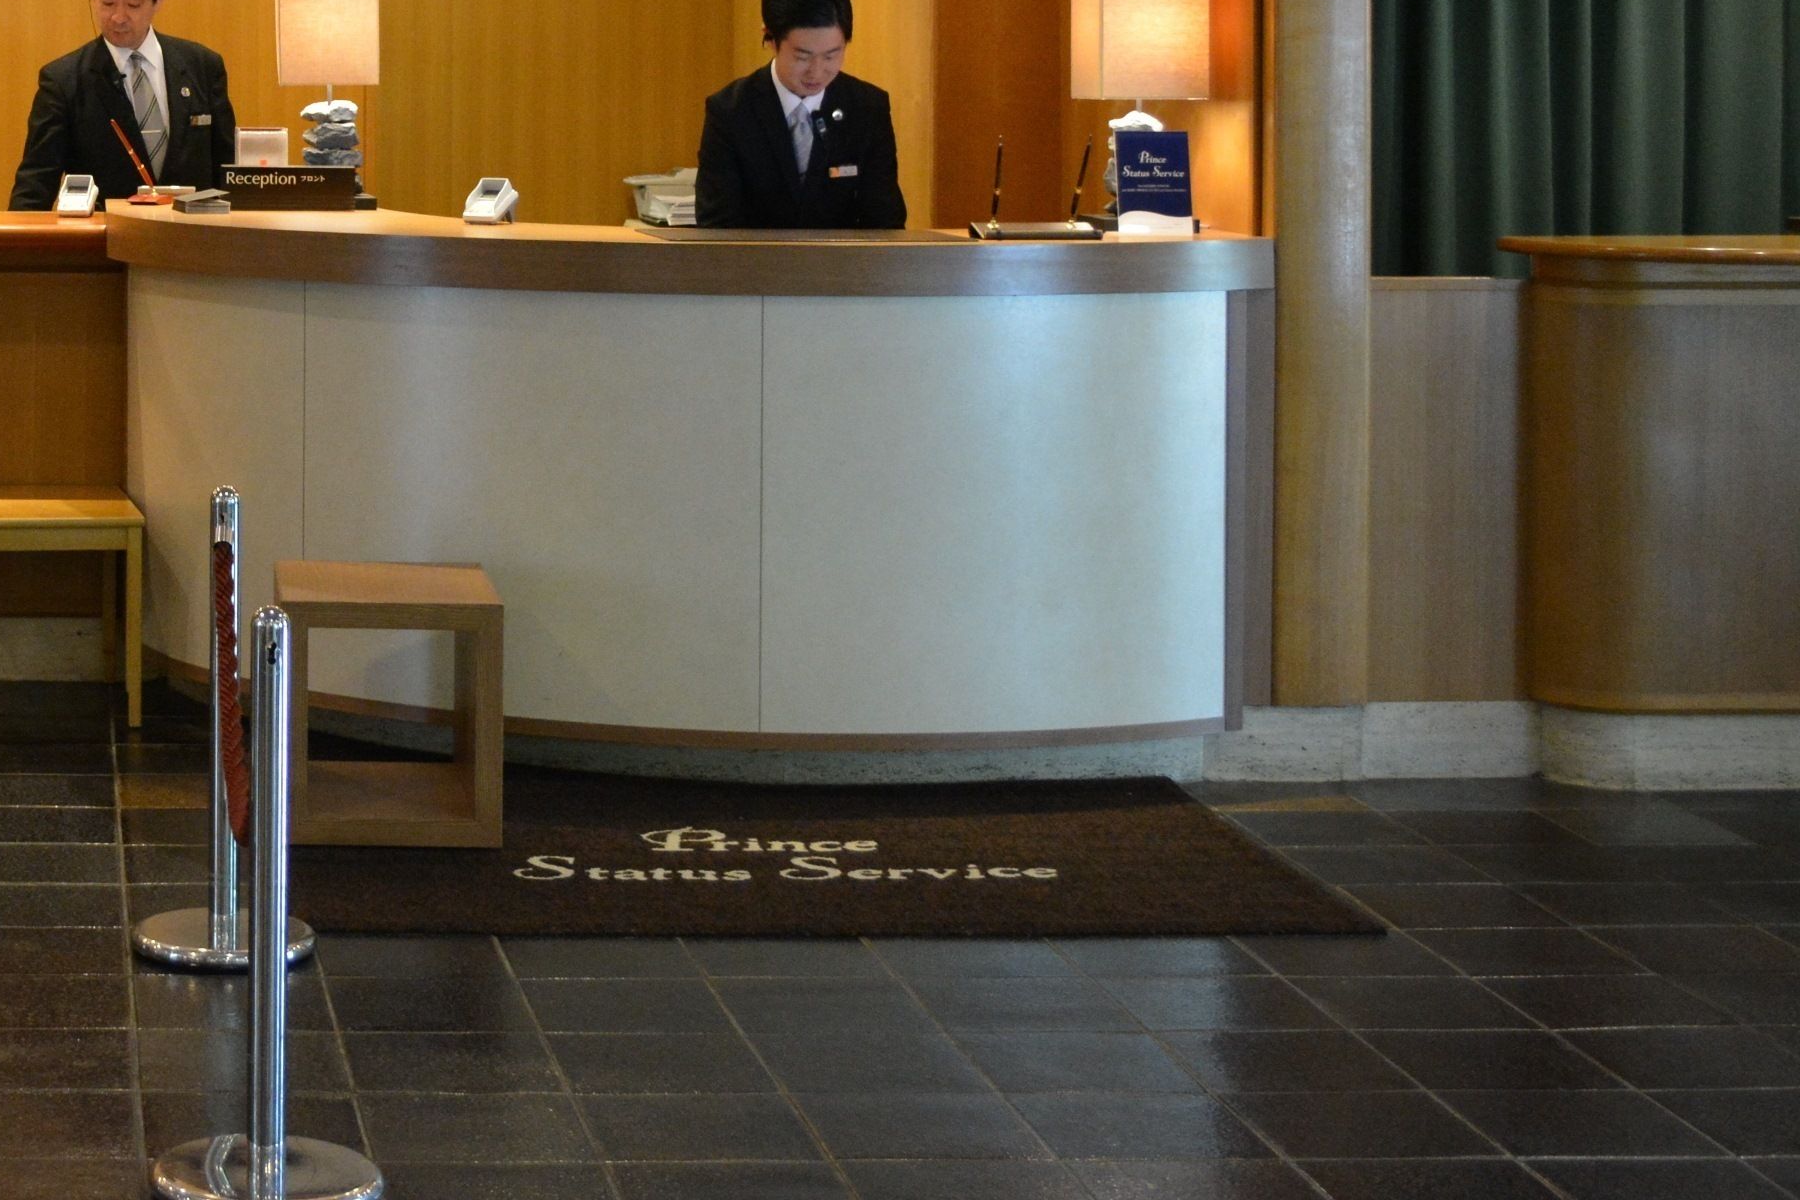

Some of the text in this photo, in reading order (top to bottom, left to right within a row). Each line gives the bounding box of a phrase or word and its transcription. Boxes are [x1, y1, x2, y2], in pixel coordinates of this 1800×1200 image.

[1138, 150, 1167, 164] Prince
[300, 175, 326, 183] フロント
[1122, 165, 1185, 177] Status Service
[225, 171, 297, 189] Reception
[639, 825, 878, 853] Prince
[512, 855, 1059, 882] Status Service
